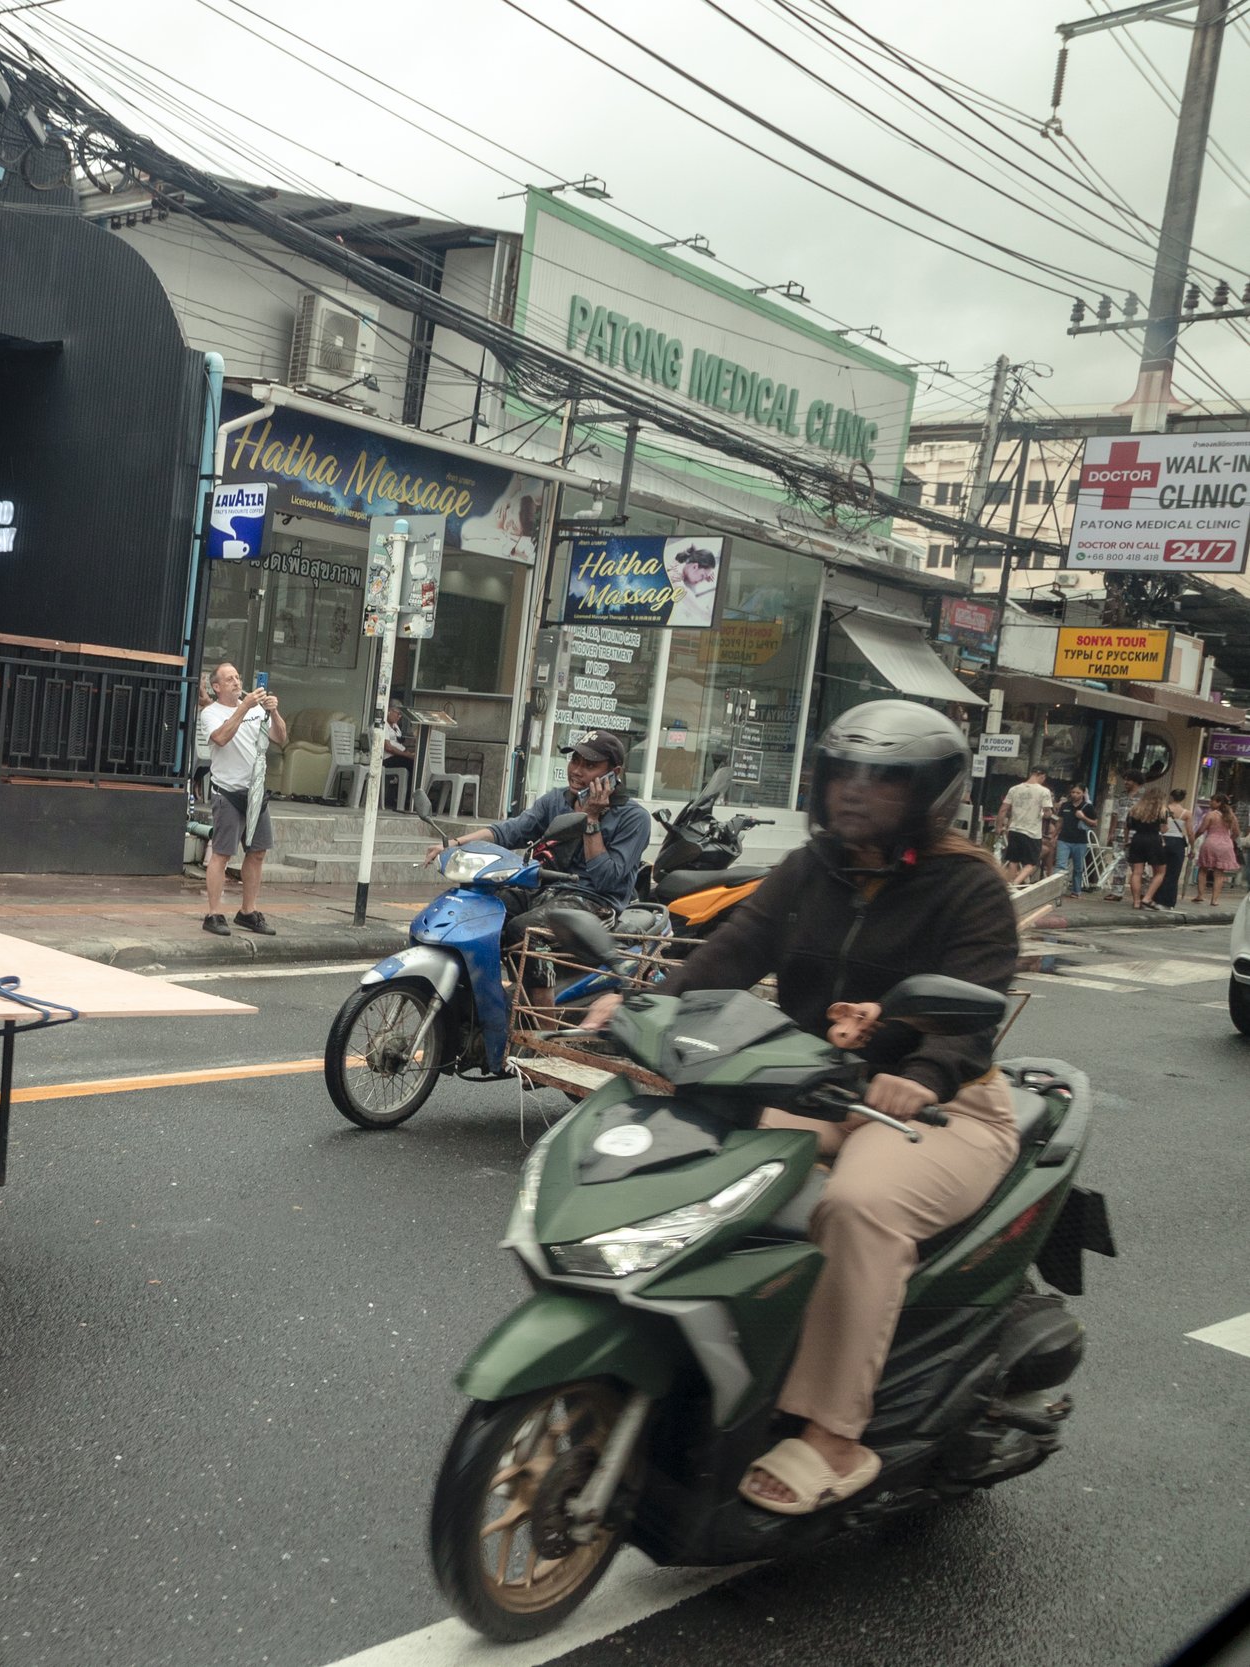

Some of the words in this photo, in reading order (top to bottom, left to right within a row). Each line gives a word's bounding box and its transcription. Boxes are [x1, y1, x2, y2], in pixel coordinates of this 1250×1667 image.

[567, 294, 684, 390] PATONG
[689, 348, 801, 438] MEDICAL
[805, 398, 879, 464] CLINIC
[230, 420, 342, 487] Hatha
[344, 449, 473, 518] Massage
[1166, 454, 1250, 474] WALK-IN
[1088, 470, 1151, 482] DOCTOR
[215, 489, 264, 507] LAVAZZA
[291, 495, 317, 509] Licensed
[1158, 483, 1247, 509] CLINIC
[1080, 520, 1133, 529] PATONG
[1135, 520, 1192, 529] MEDICAL
[1196, 519, 1241, 529] CLINIC
[1077, 541, 1116, 549] DOCTOR
[1119, 541, 1134, 549] ON
[1136, 541, 1160, 549] CALL
[1169, 542, 1232, 561] 24/7
[578, 551, 663, 580] Hatha
[578, 584, 688, 612] Massage
[600, 627, 624, 644] WOUND
[624, 631, 641, 648] CARE
[1076, 635, 1112, 647] SONYA
[1116, 637, 1147, 648] TOUR
[598, 644, 633, 664] TREATMENT
[1064, 649, 1093, 660] ТУРЫ
[1096, 650, 1104, 660] С
[1106, 651, 1160, 662] РУССКИМ
[593, 662, 609, 677] DRIP
[1087, 664, 1129, 676] ГИДОМ
[573, 676, 600, 693] VITAMIN
[600, 680, 616, 695] DRIP
[568, 693, 588, 708] RAPID
[588, 696, 601, 710] STD
[601, 697, 617, 712] TEST
[554, 709, 573, 724] RAVEL
[573, 711, 609, 728] INSURANCE
[608, 715, 631, 732] ACCEPT
